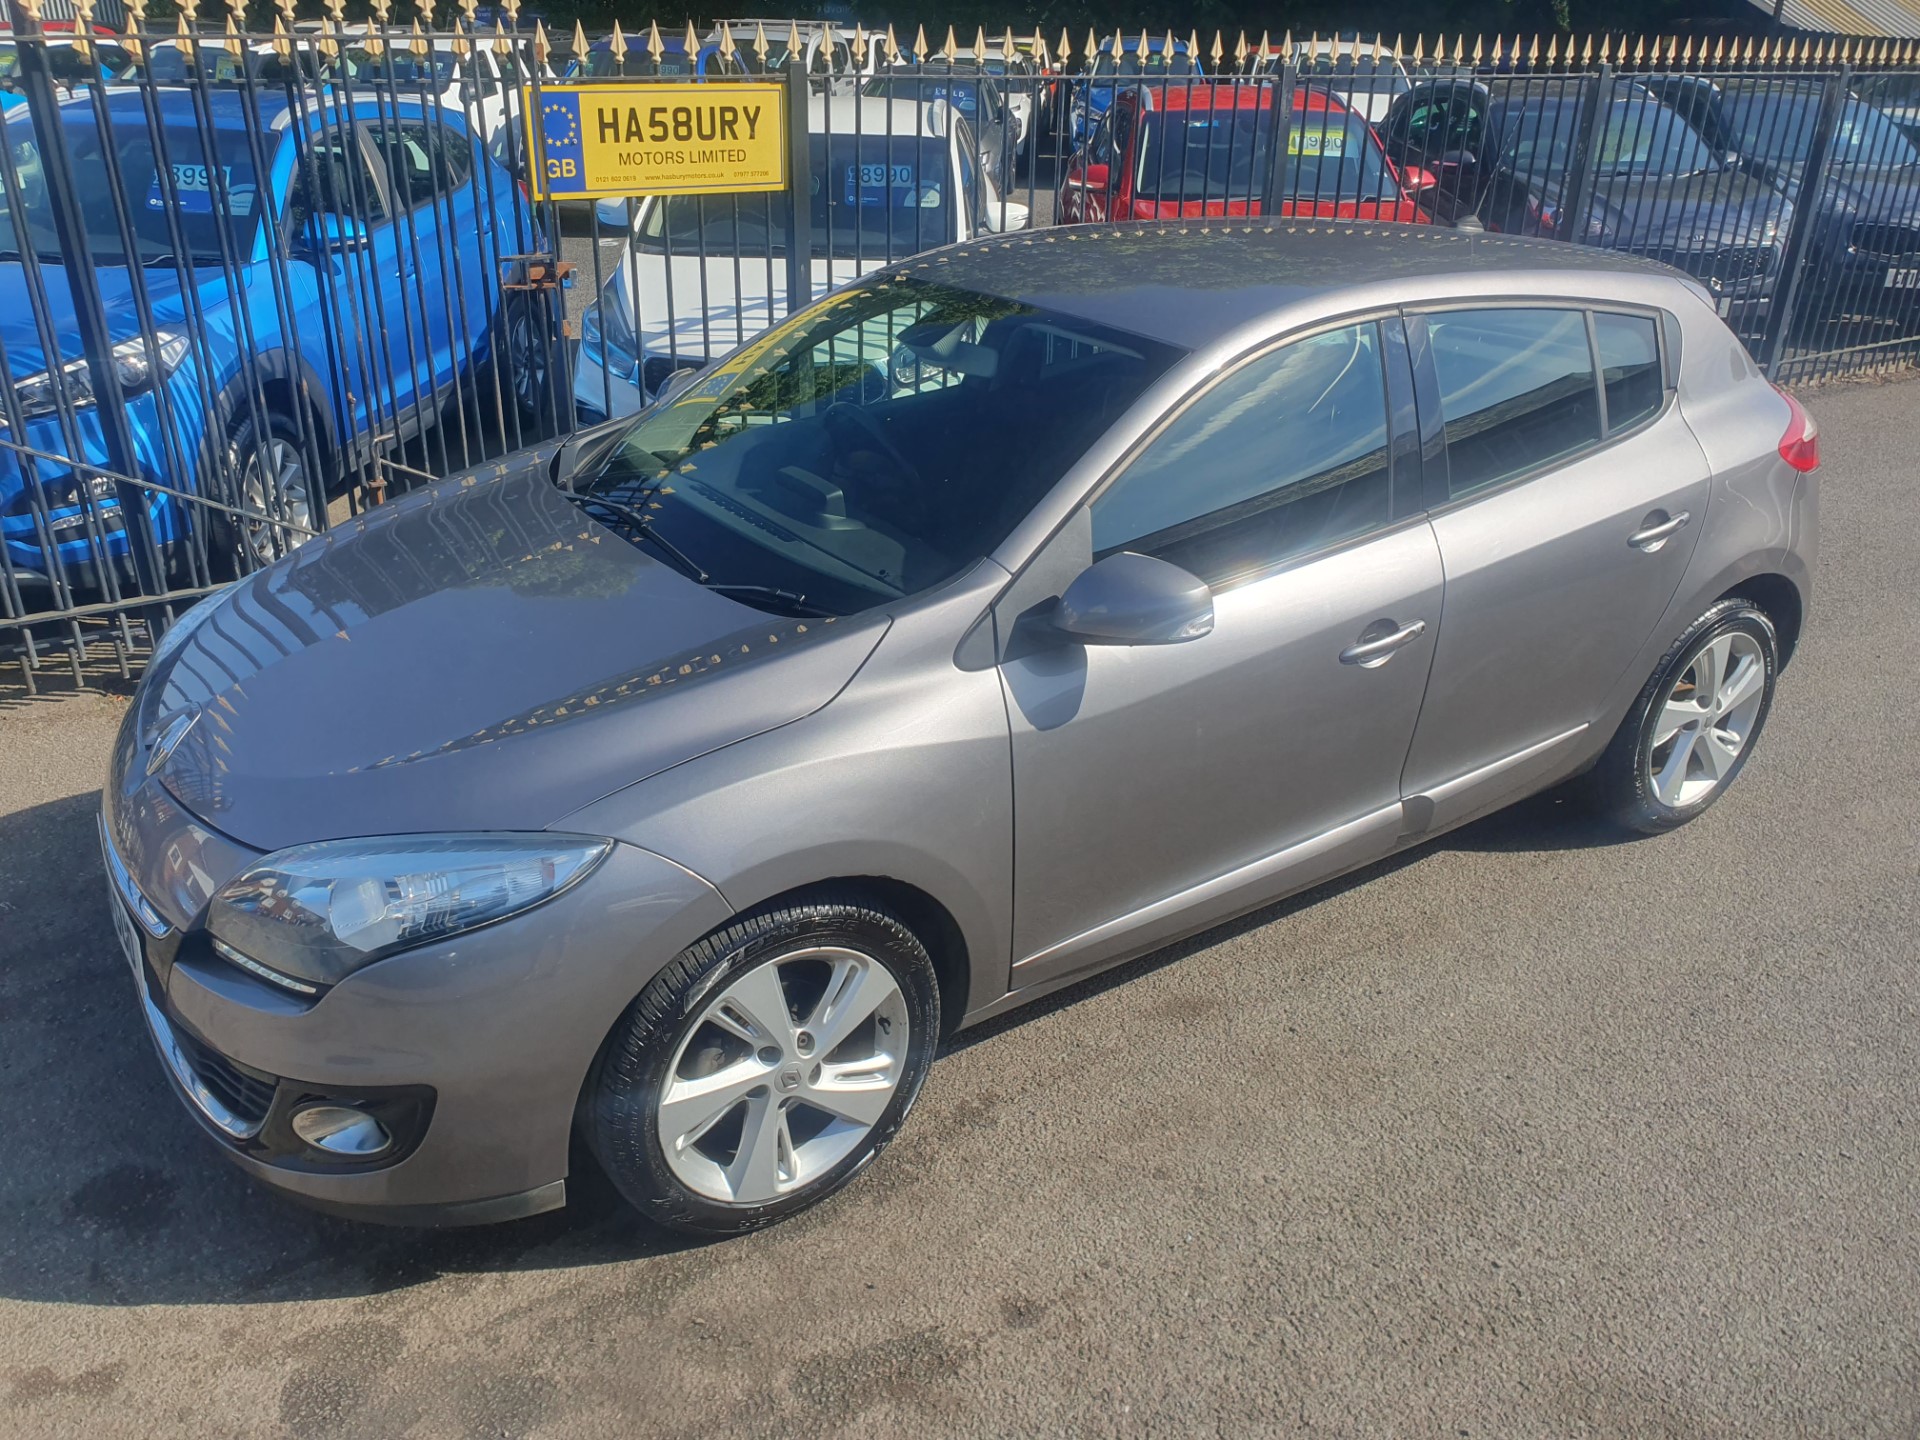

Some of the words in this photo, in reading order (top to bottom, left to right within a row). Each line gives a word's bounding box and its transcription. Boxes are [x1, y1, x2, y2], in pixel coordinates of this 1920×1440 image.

[597, 105, 761, 143] HA58URY
[618, 150, 684, 166] MOTORS
[689, 149, 747, 163] LIMITED
[546, 158, 577, 178] GB
